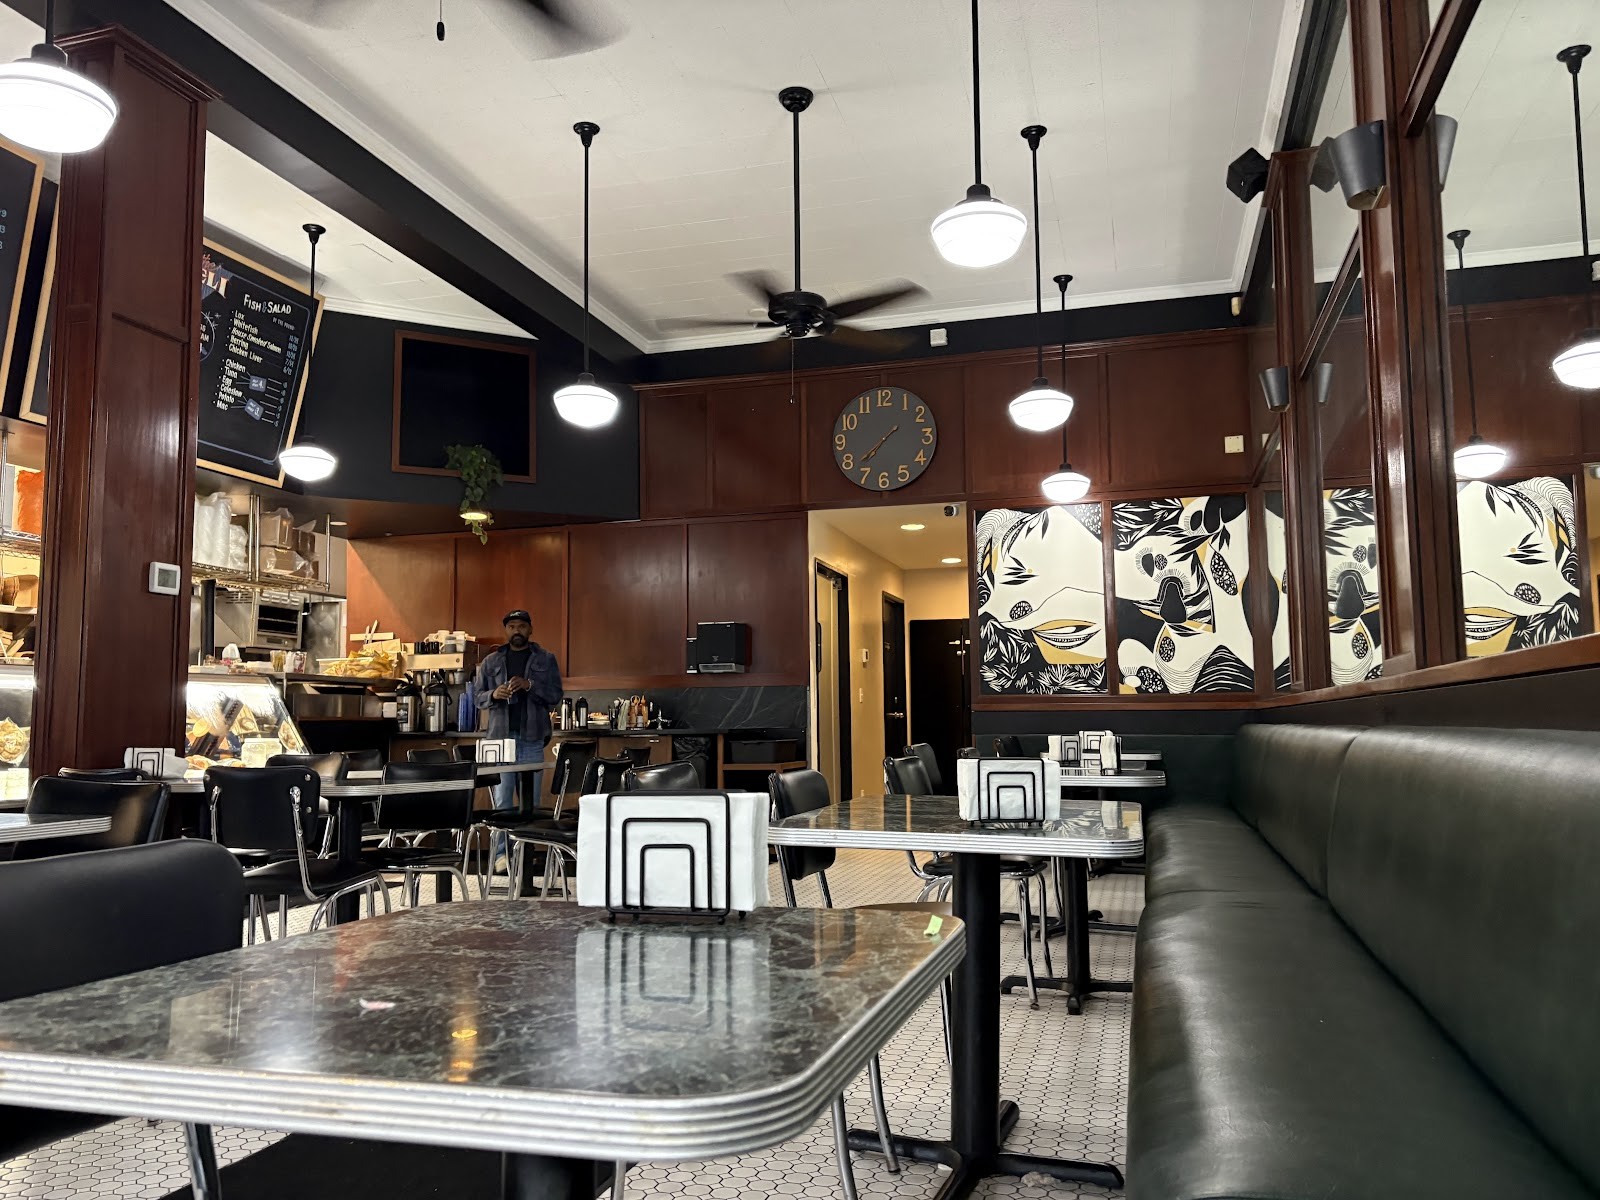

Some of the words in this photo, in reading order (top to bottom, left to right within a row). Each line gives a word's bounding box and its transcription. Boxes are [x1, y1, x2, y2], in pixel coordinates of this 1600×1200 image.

[244, 294, 261, 312] FISH
[267, 301, 291, 314] SALAD
[235, 310, 245, 320] Lox
[233, 318, 258, 335] Whitefish
[230, 335, 248, 350] Herring
[231, 326, 248, 339] House
[247, 334, 268, 348] Smoked
[267, 342, 281, 354] Salmon
[229, 343, 248, 358] Chicken
[250, 351, 263, 363] Liver
[225, 366, 237, 378] Tuna
[226, 359, 245, 372] Chicken
[222, 375, 232, 386] Egg
[217, 400, 228, 410] Mac
[219, 392, 234, 403] Potato
[859, 396, 870, 414] 11
[876, 390, 892, 407] 12
[902, 394, 908, 411] 1
[842, 414, 858, 431] 10
[916, 406, 925, 422] 2
[835, 434, 846, 451] 9
[922, 428, 933, 445] 3
[842, 454, 854, 470] 8
[914, 449, 926, 466] 4
[860, 467, 870, 484] 7
[878, 472, 890, 488] 6
[898, 465, 910, 482] 5
